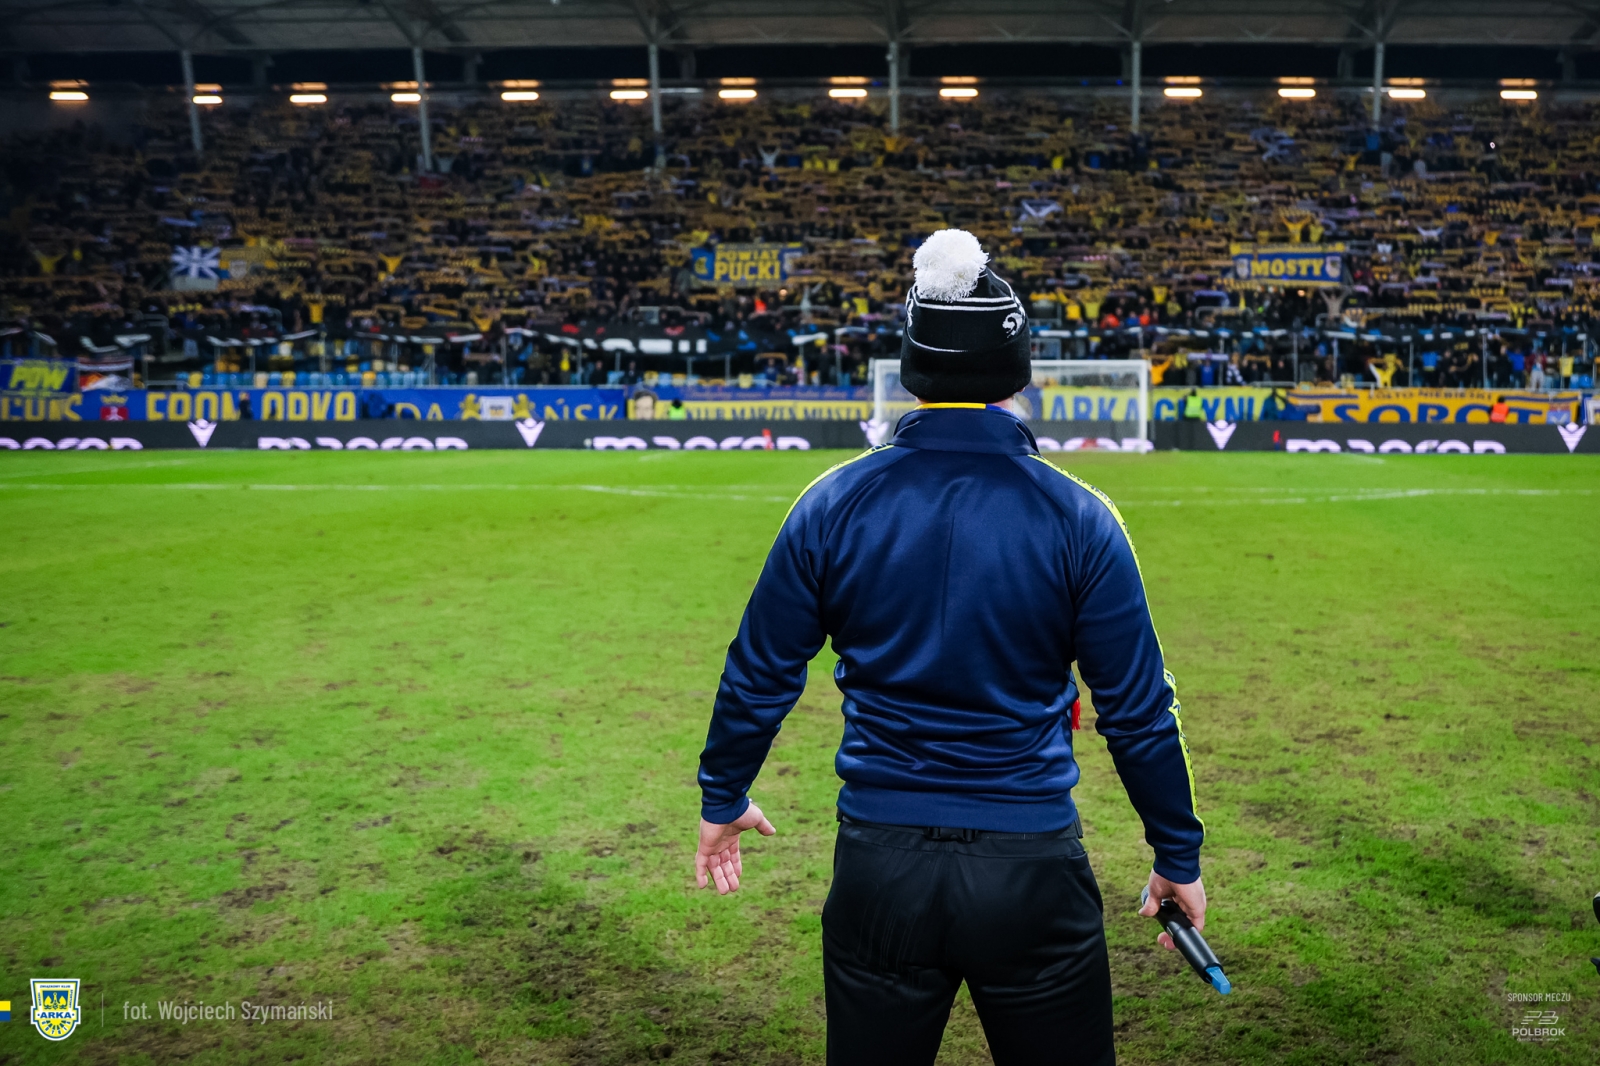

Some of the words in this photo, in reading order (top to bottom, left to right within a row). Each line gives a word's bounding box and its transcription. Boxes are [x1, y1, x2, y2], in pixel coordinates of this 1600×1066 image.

[714, 261, 781, 281] PUCKI
[1250, 258, 1324, 277] MOSTY
[1050, 395, 1141, 421] ARKA
